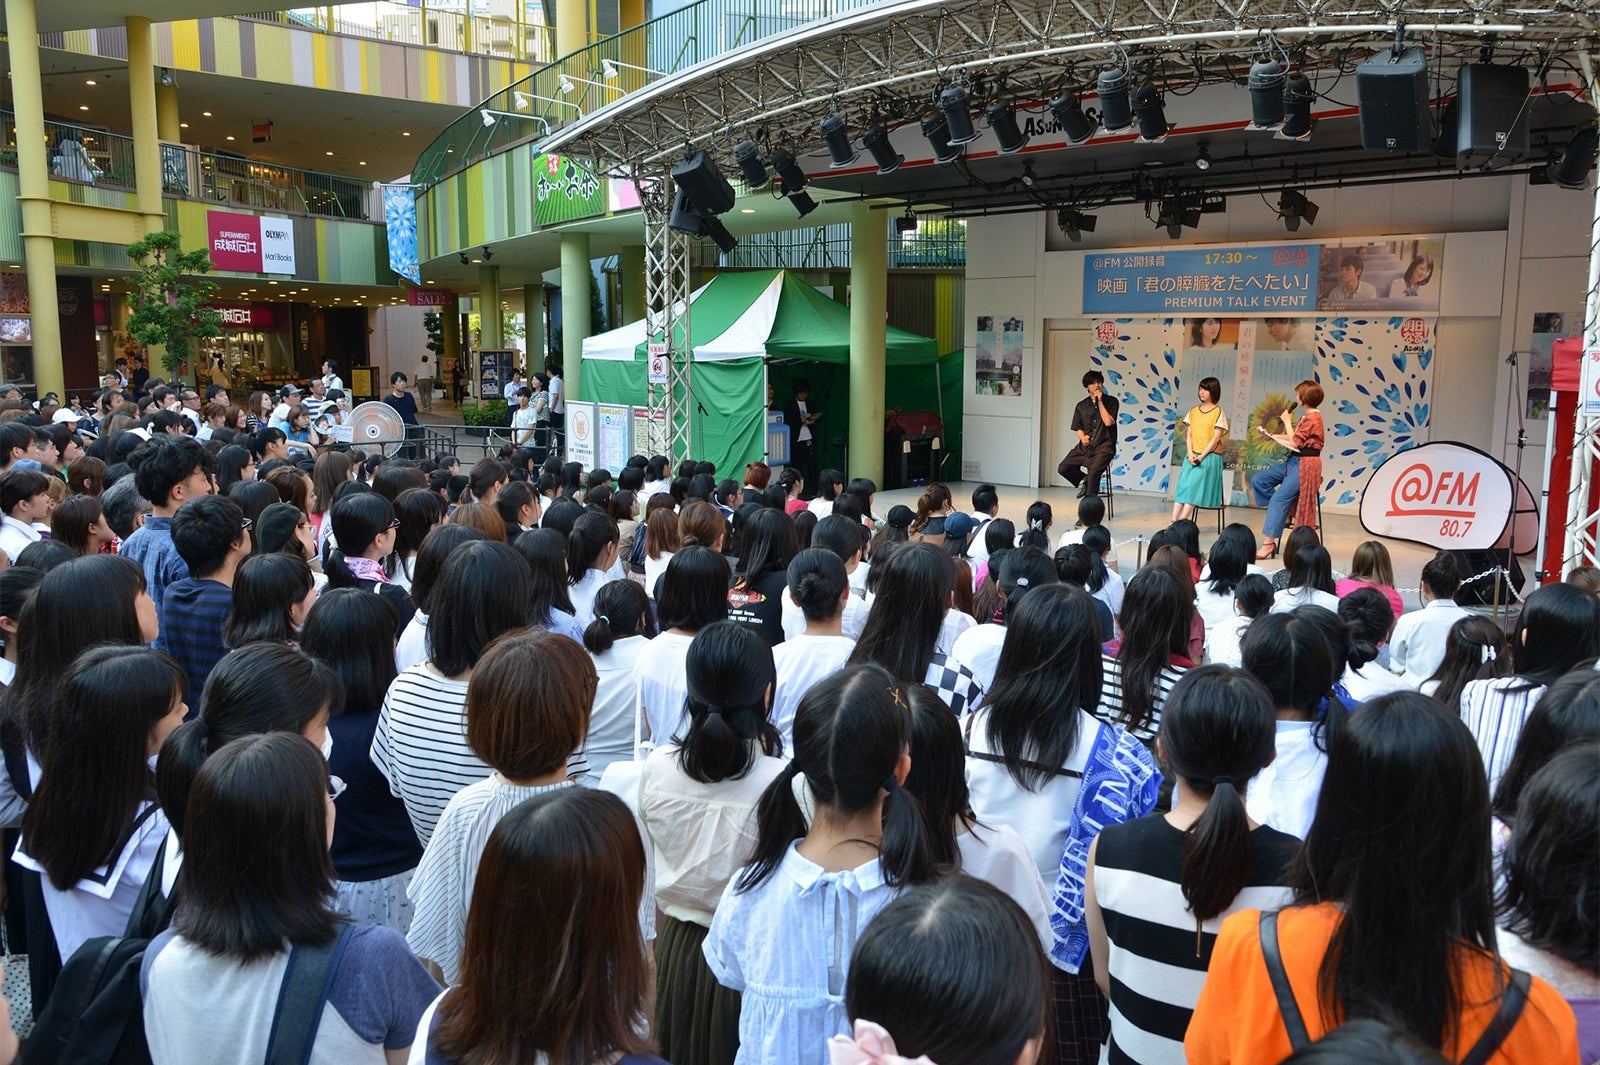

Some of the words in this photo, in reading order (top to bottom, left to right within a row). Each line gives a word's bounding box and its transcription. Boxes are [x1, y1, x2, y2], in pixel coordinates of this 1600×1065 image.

[219, 231, 250, 239] SUPERMARKET
[214, 239, 257, 254] 成城石井
[277, 254, 292, 262] Books
[1123, 256, 1166, 268] 公開録音
[1205, 252, 1242, 265] 17:30
[1164, 297, 1223, 308] PREMIUM
[1227, 296, 1259, 307] TALK
[1263, 295, 1307, 307] EVENT
[1390, 463, 1481, 510] @FM
[1439, 519, 1473, 538] 80.7
